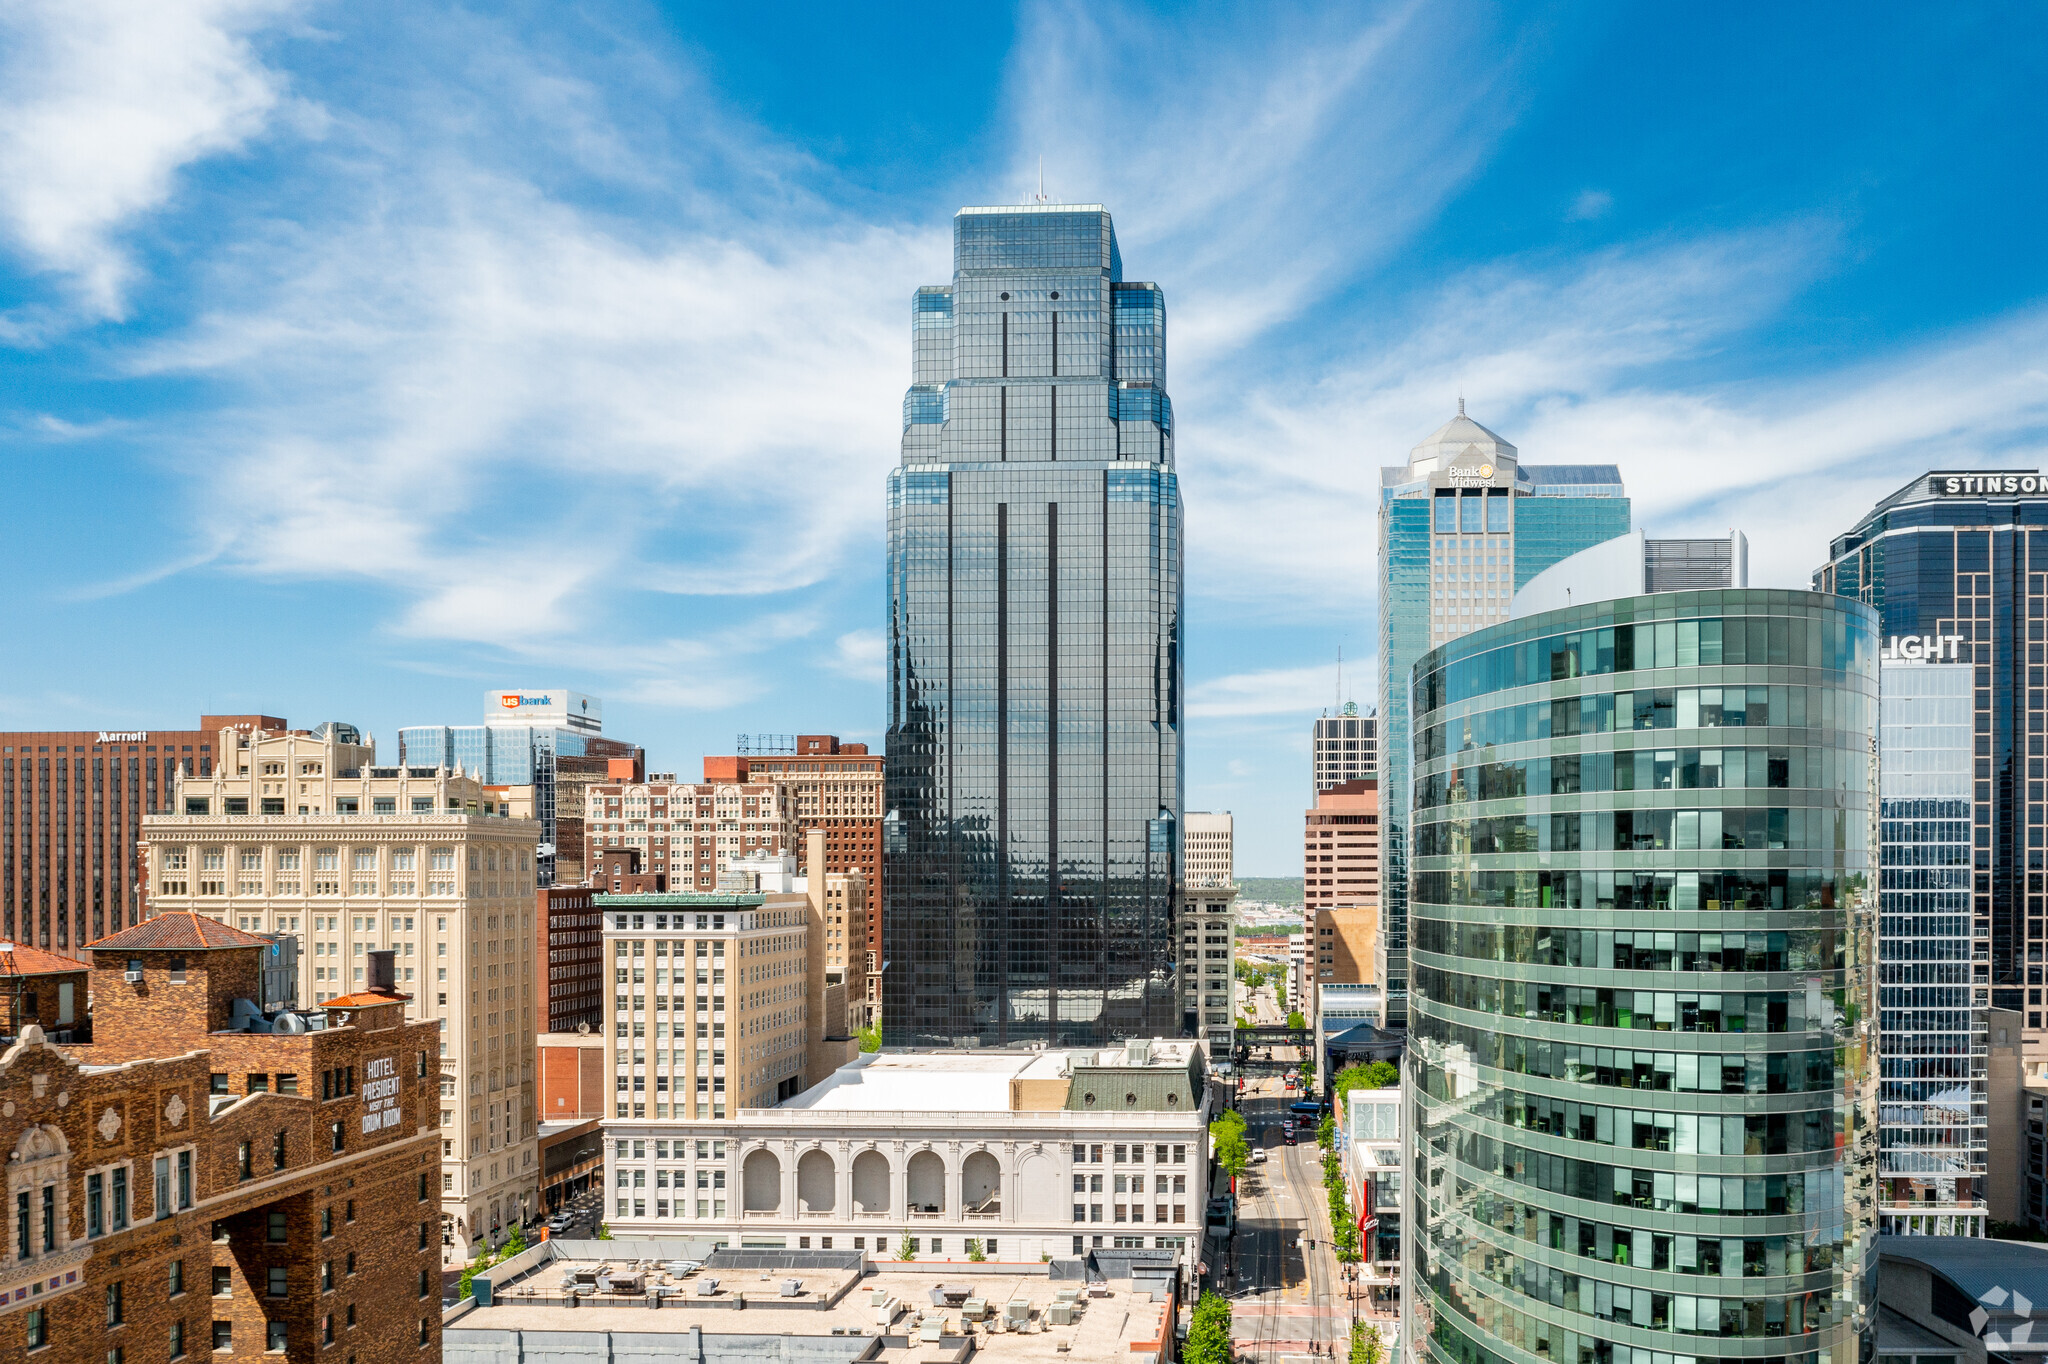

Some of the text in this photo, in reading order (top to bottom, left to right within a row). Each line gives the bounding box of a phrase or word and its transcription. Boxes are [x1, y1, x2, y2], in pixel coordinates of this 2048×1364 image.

[1449, 466, 1480, 477] Bank
[1449, 477, 1497, 488] Midwest
[1946, 477, 2048, 493] STINSON
[1881, 635, 1964, 659] IGHT
[95, 731, 147, 743] Marriott
[367, 1057, 395, 1079] HOTEL
[362, 1076, 400, 1101] PRESIDENT
[383, 1097, 395, 1108] THE
[362, 1107, 401, 1134] DRUM ROOM
